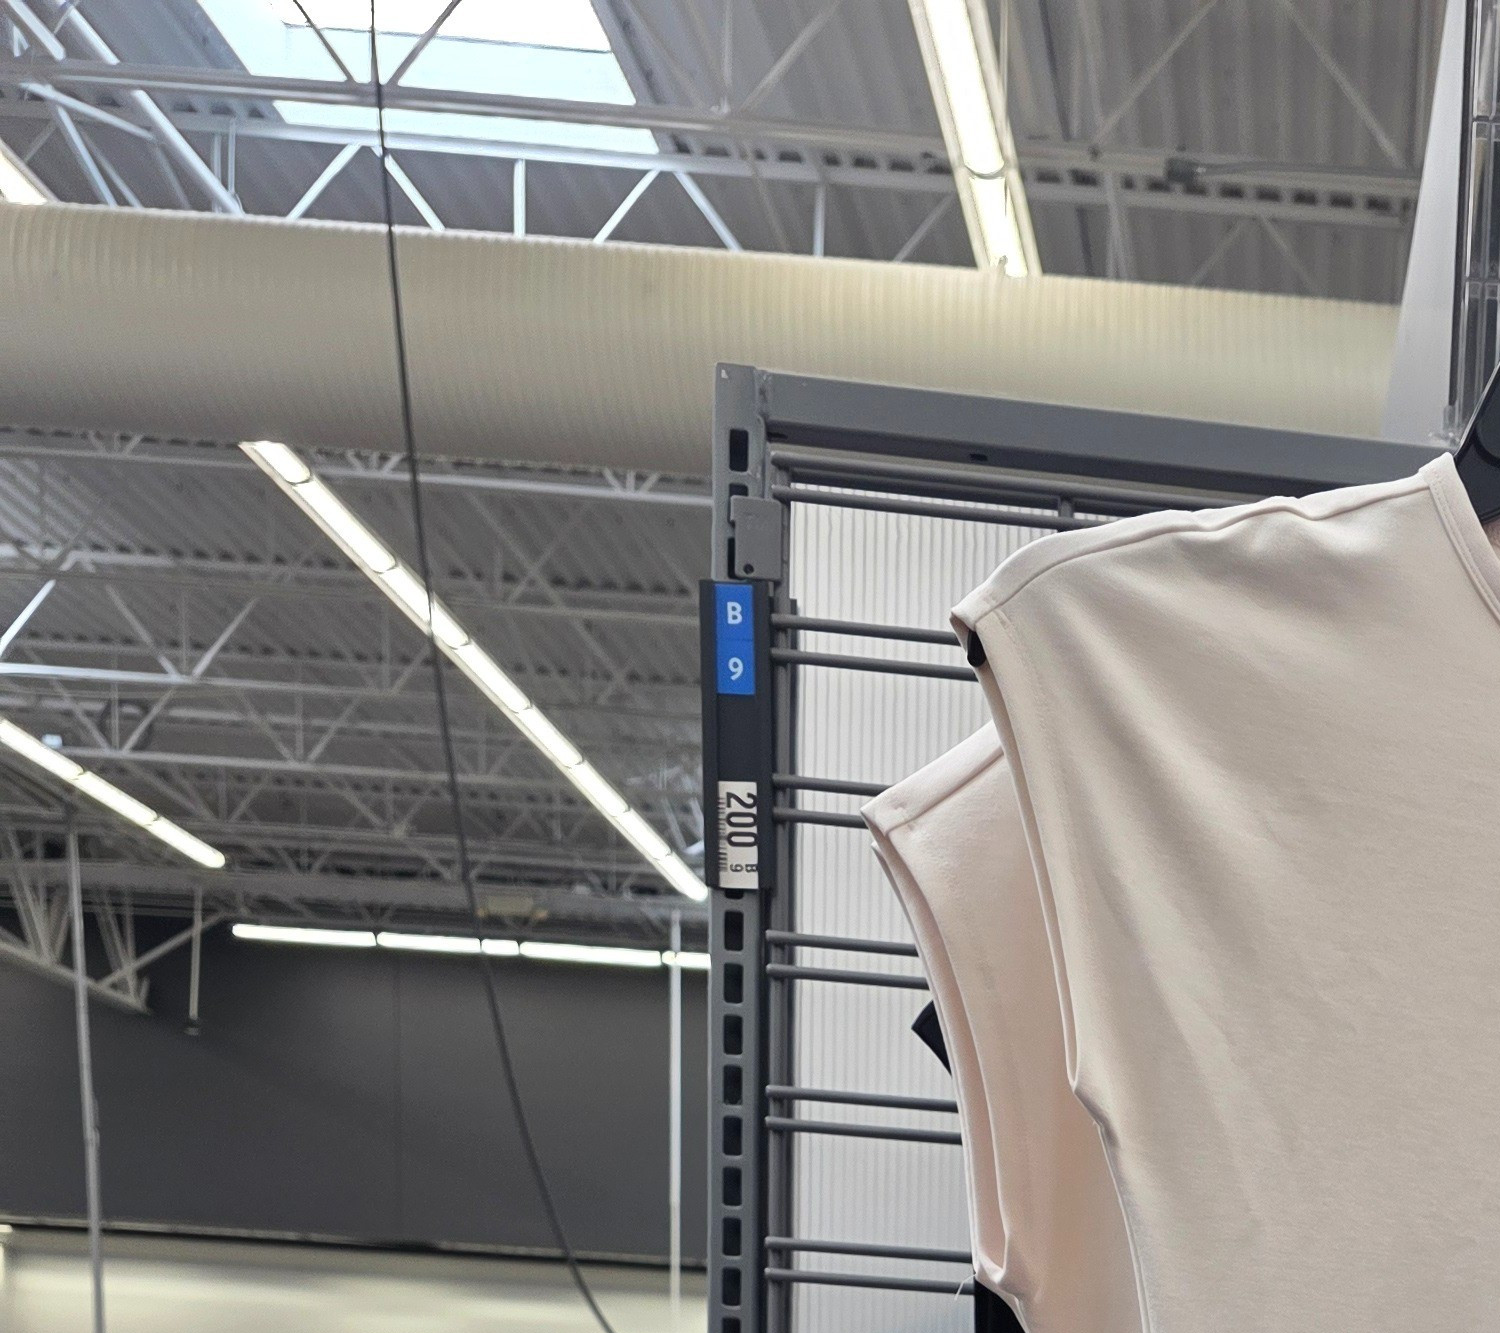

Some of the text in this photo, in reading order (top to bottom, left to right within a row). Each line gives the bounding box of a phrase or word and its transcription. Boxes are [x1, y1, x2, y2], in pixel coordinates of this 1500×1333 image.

[726, 601, 743, 625] B
[728, 657, 744, 681] 9
[726, 791, 758, 848] 200
